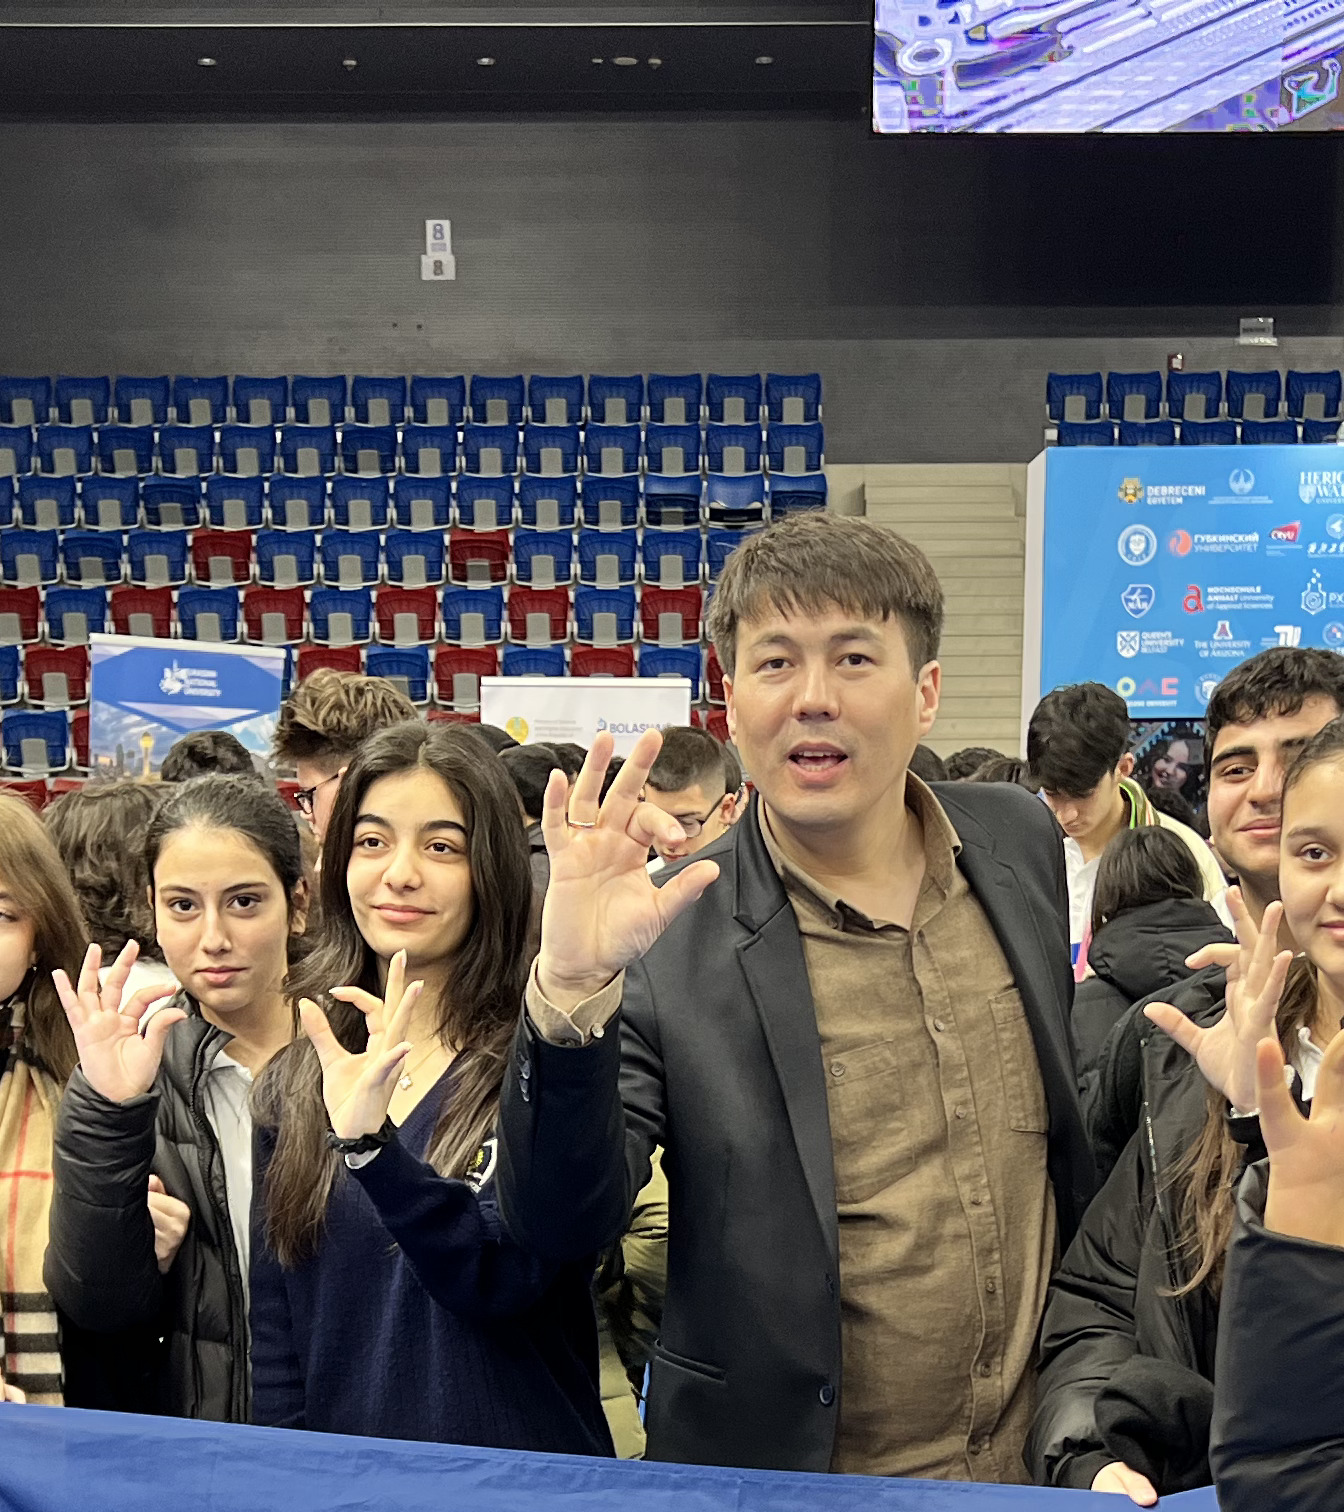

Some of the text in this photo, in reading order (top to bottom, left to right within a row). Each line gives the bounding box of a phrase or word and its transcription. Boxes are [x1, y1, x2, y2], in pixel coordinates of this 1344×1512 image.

[433, 223, 444, 240] 8
[433, 260, 443, 276] 8
[1146, 485, 1206, 496] DEBRECENI
[1194, 531, 1259, 543] ГУБКИНСКИЙ
[1194, 543, 1258, 553] УНИВЕРСИТЕТ
